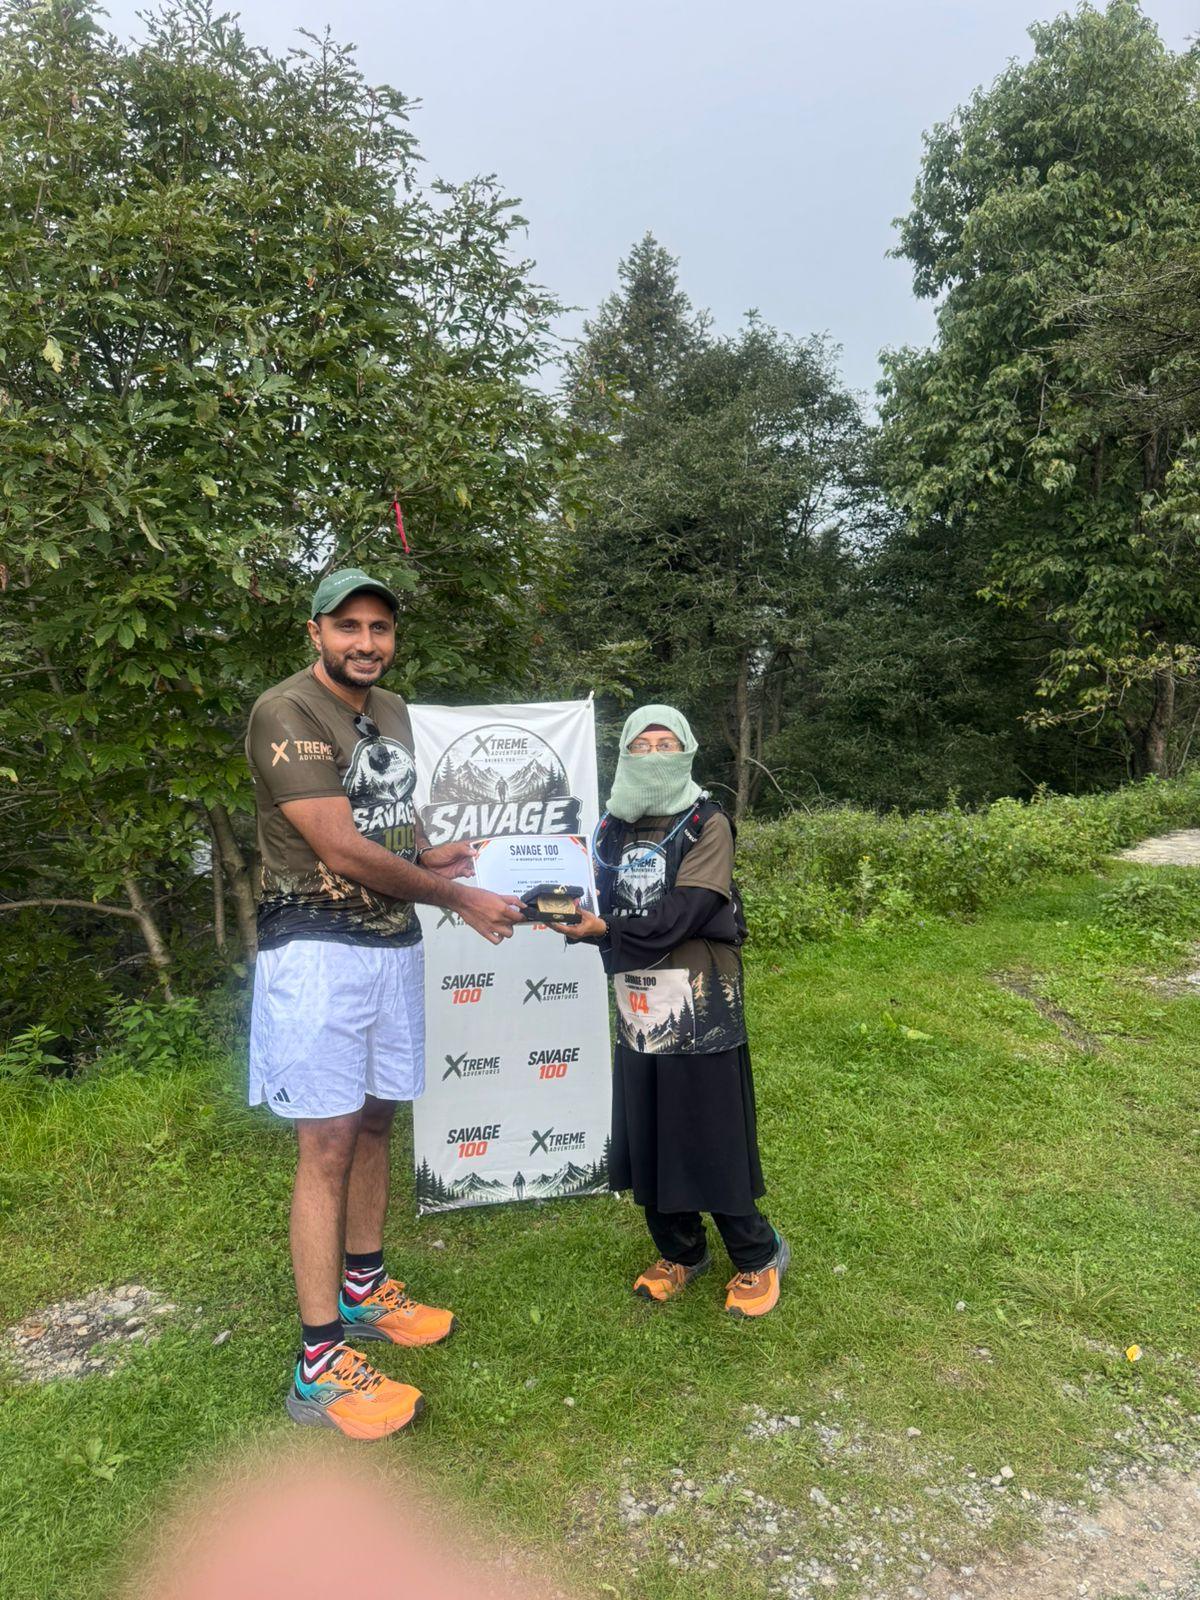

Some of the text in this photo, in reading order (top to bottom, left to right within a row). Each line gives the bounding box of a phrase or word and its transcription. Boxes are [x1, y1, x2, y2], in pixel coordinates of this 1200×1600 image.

[471, 734, 528, 758] XTREME
[426, 800, 569, 844] SAVAGE
[510, 844, 559, 856] SAVAGE 100
[441, 972, 495, 990] SAVAGE
[643, 976, 657, 987] 100
[452, 988, 482, 1005] 100
[522, 977, 579, 1005] XTREME
[528, 1047, 580, 1066] SAVAGE
[442, 1051, 500, 1082] XTREME
[539, 1063, 568, 1080] 100
[447, 1124, 501, 1144] SAVAGE
[529, 1127, 586, 1156] XTREME
[458, 1141, 488, 1158] 100
